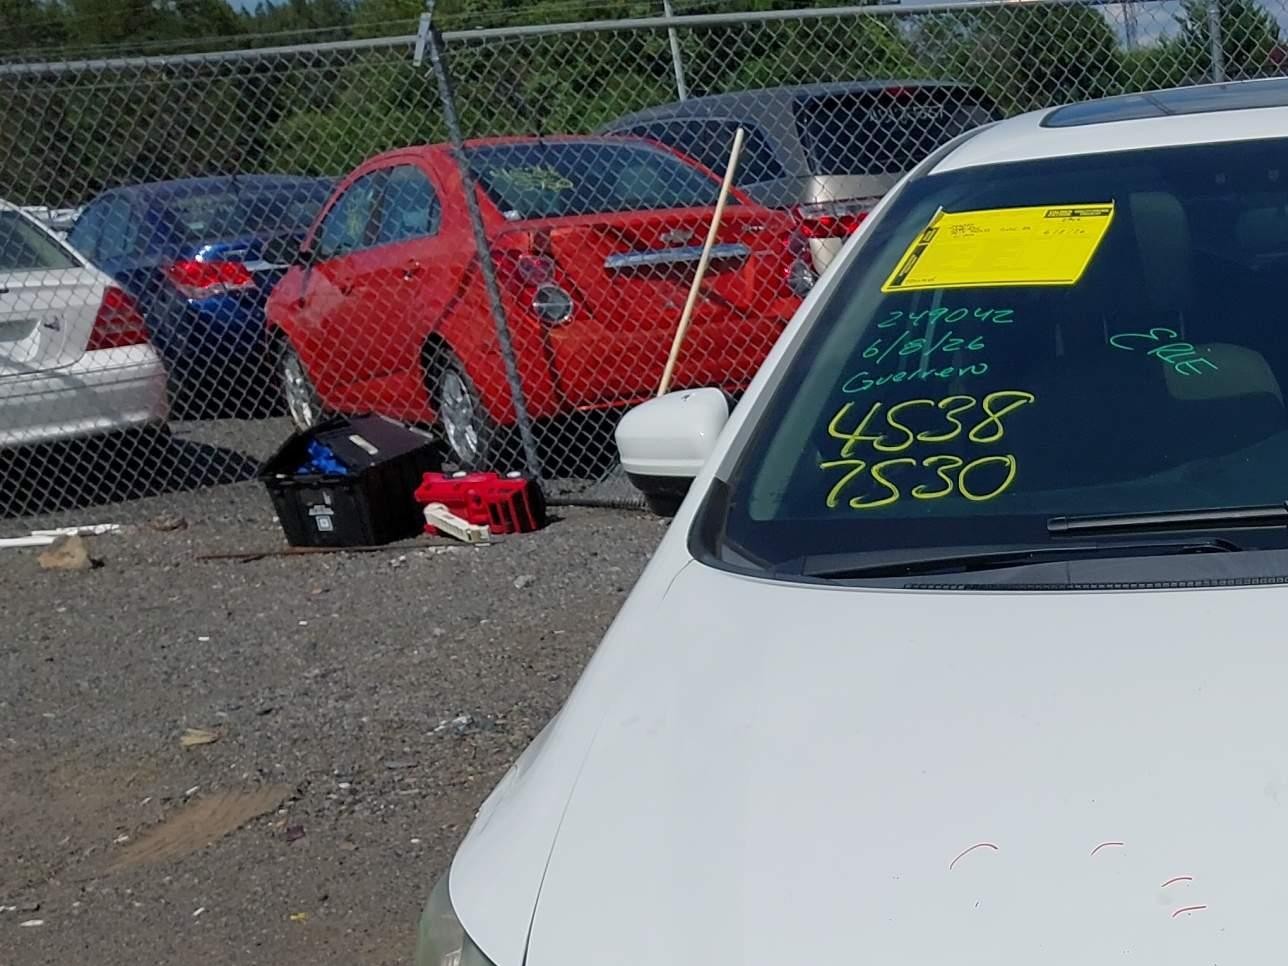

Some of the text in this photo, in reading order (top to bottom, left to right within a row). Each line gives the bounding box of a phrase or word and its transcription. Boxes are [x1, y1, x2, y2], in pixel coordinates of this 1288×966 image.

[877, 307, 1016, 328] 249042
[862, 330, 986, 365] 6/8/26
[828, 390, 1035, 458] 4538
[820, 454, 1016, 508] 7530
